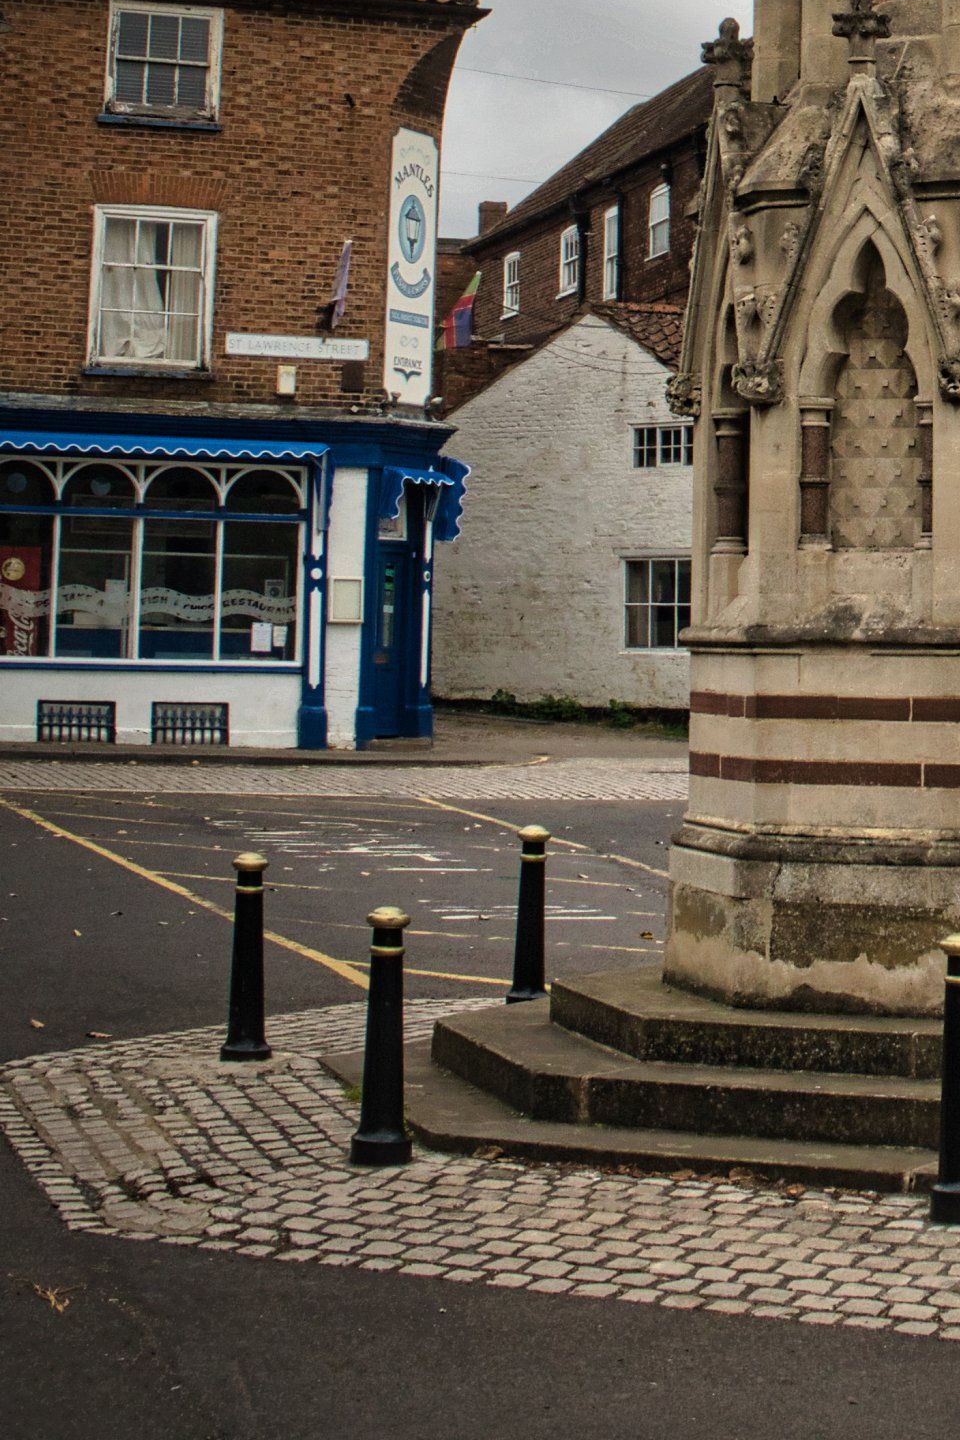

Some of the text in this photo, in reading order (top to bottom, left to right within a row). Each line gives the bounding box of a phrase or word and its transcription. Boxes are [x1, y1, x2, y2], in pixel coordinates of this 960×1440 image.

[394, 163, 435, 198] MANTLES
[229, 339, 360, 356] ST LAWRENCE STREET
[393, 356, 422, 369] ENTRANCE
[222, 597, 296, 613] RESTAURANT
